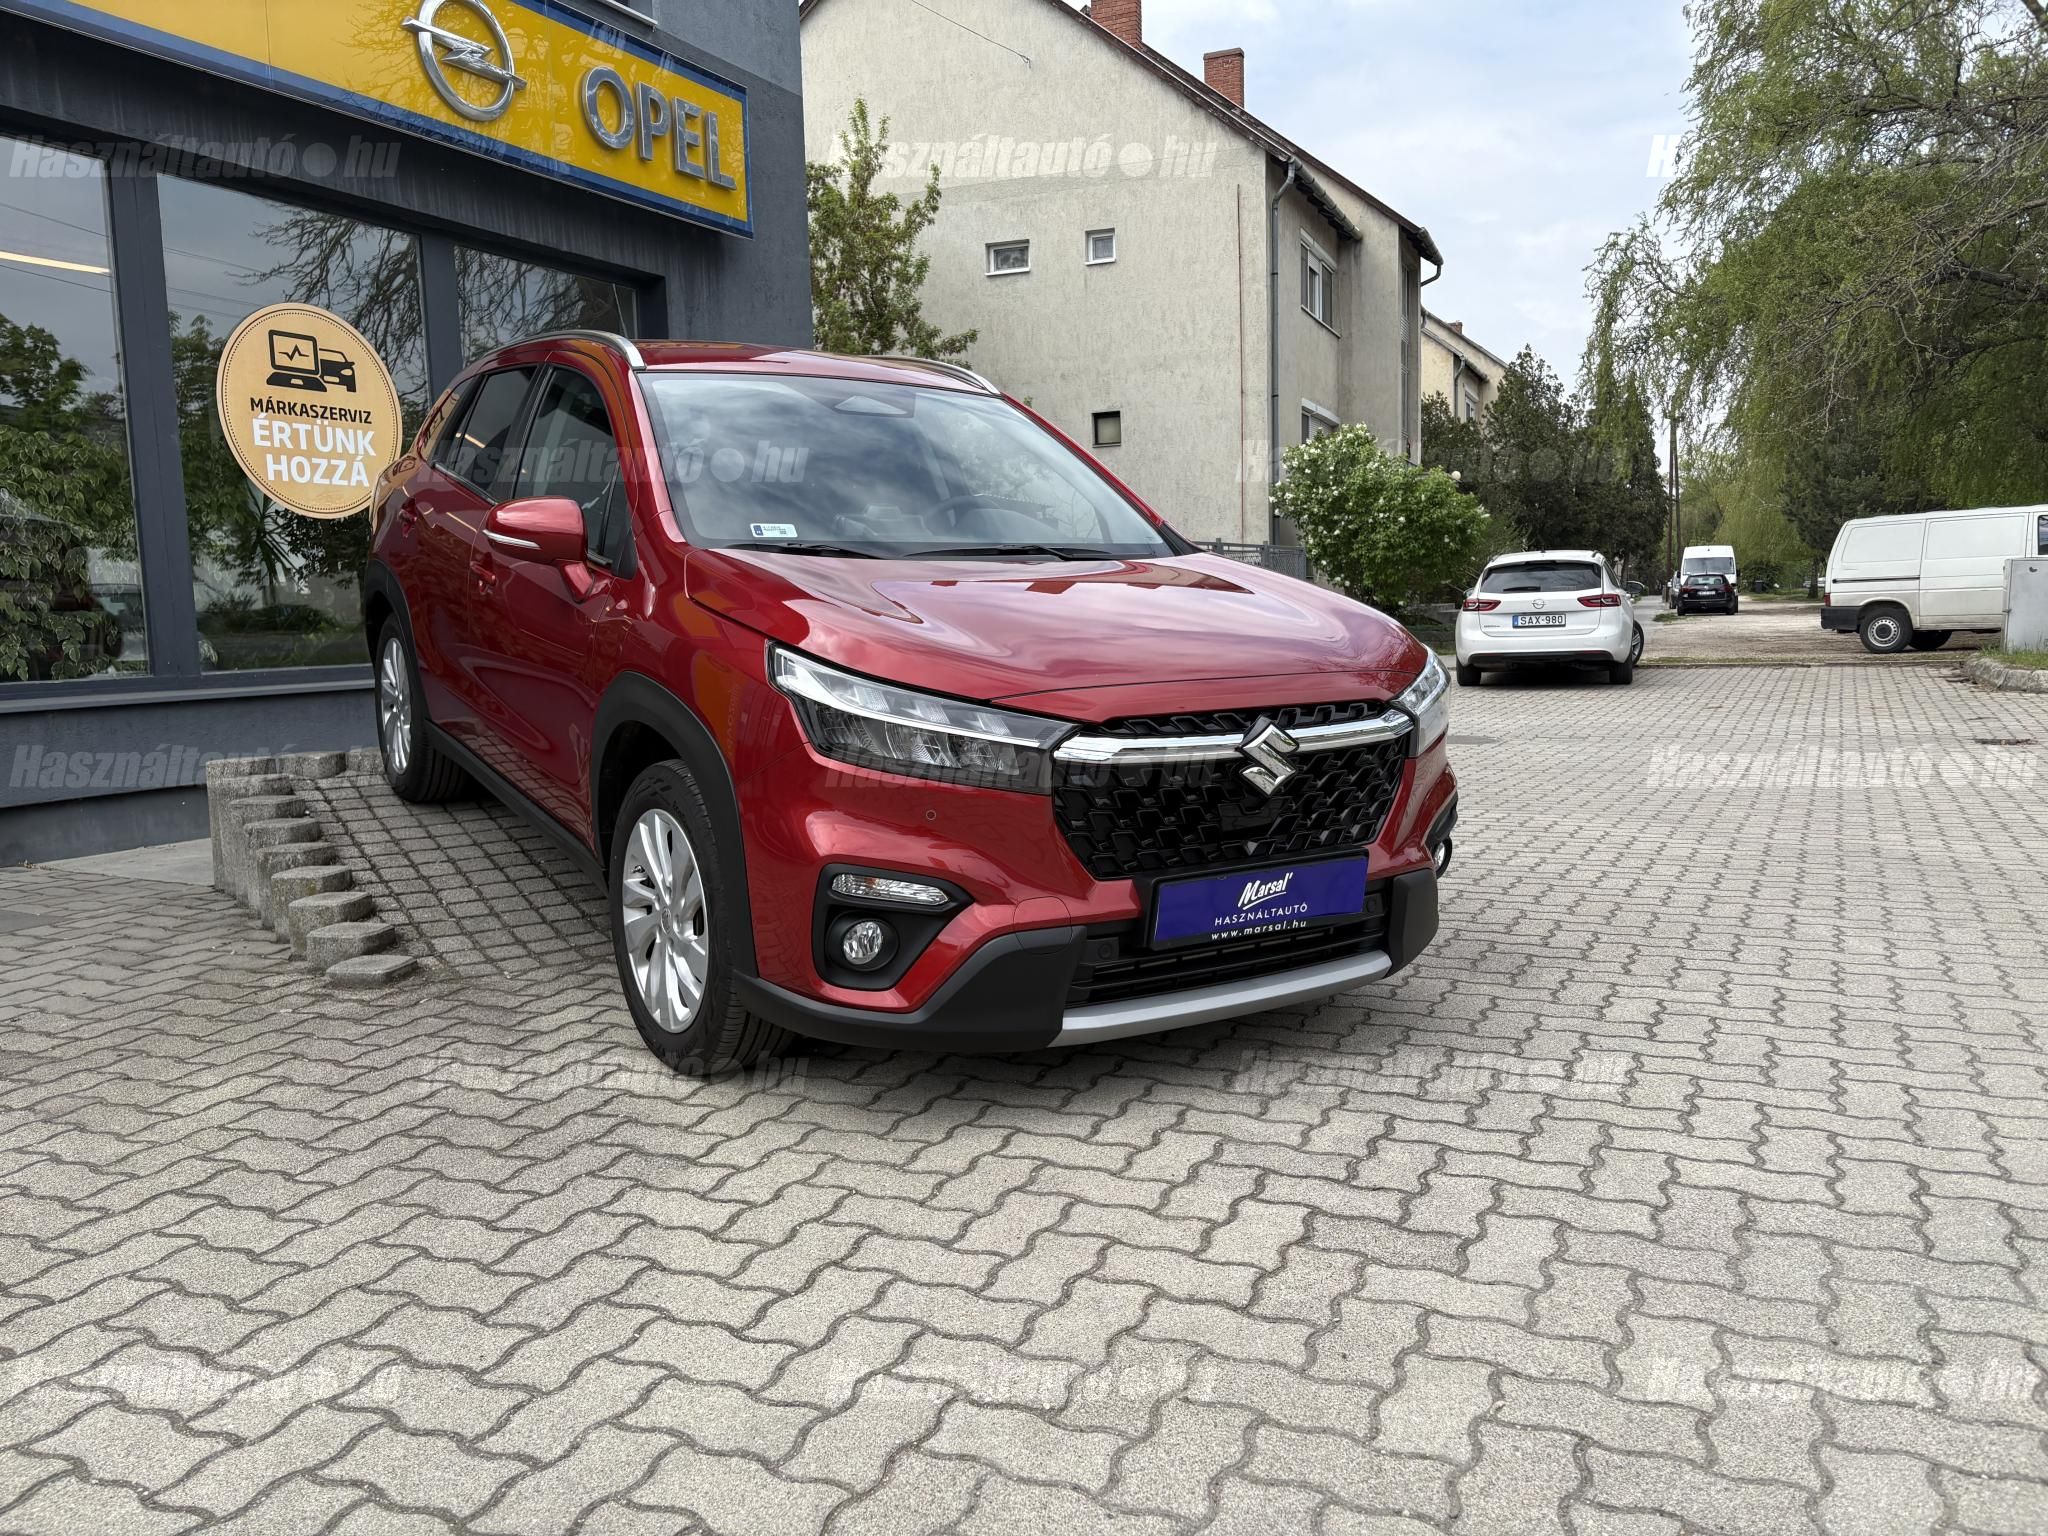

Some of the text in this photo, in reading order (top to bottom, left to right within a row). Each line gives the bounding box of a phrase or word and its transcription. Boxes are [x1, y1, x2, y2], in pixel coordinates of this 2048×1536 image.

[582, 66, 736, 190] OPEL
[250, 396, 373, 425] MÁRKASZERVIZ
[252, 412, 377, 457] ÉRTÜNK
[266, 453, 370, 488] HOZZÁ
[1520, 615, 1563, 626] SAX-980
[1214, 901, 1308, 926] HASZNÁLTAUTÓ
[1211, 919, 1307, 940] www.marsal.hu
